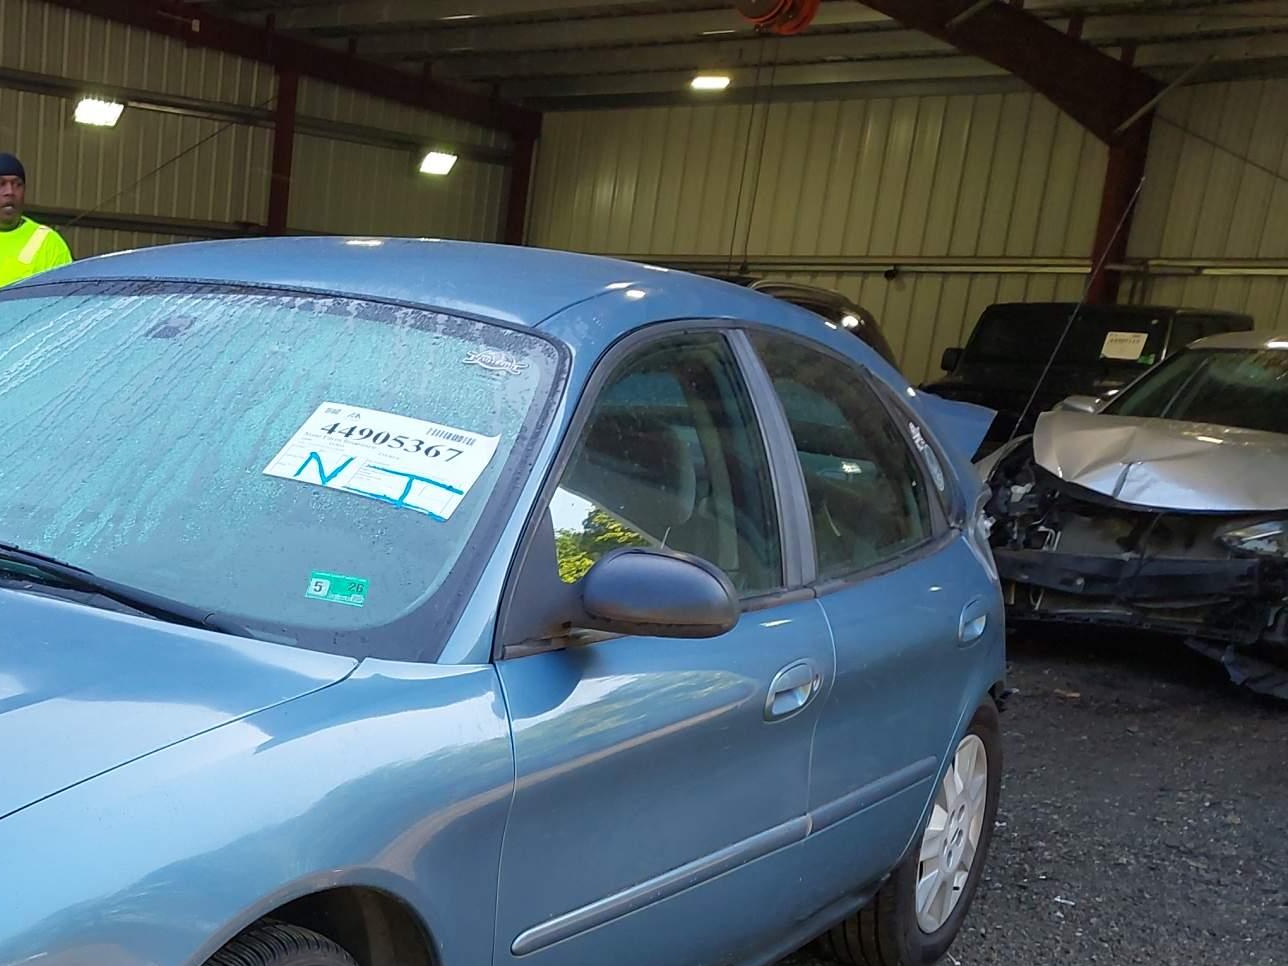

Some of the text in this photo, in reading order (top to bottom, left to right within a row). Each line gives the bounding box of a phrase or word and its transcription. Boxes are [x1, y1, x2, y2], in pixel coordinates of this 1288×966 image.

[320, 422, 465, 463] 44905367
[313, 581, 364, 593] 5 26
